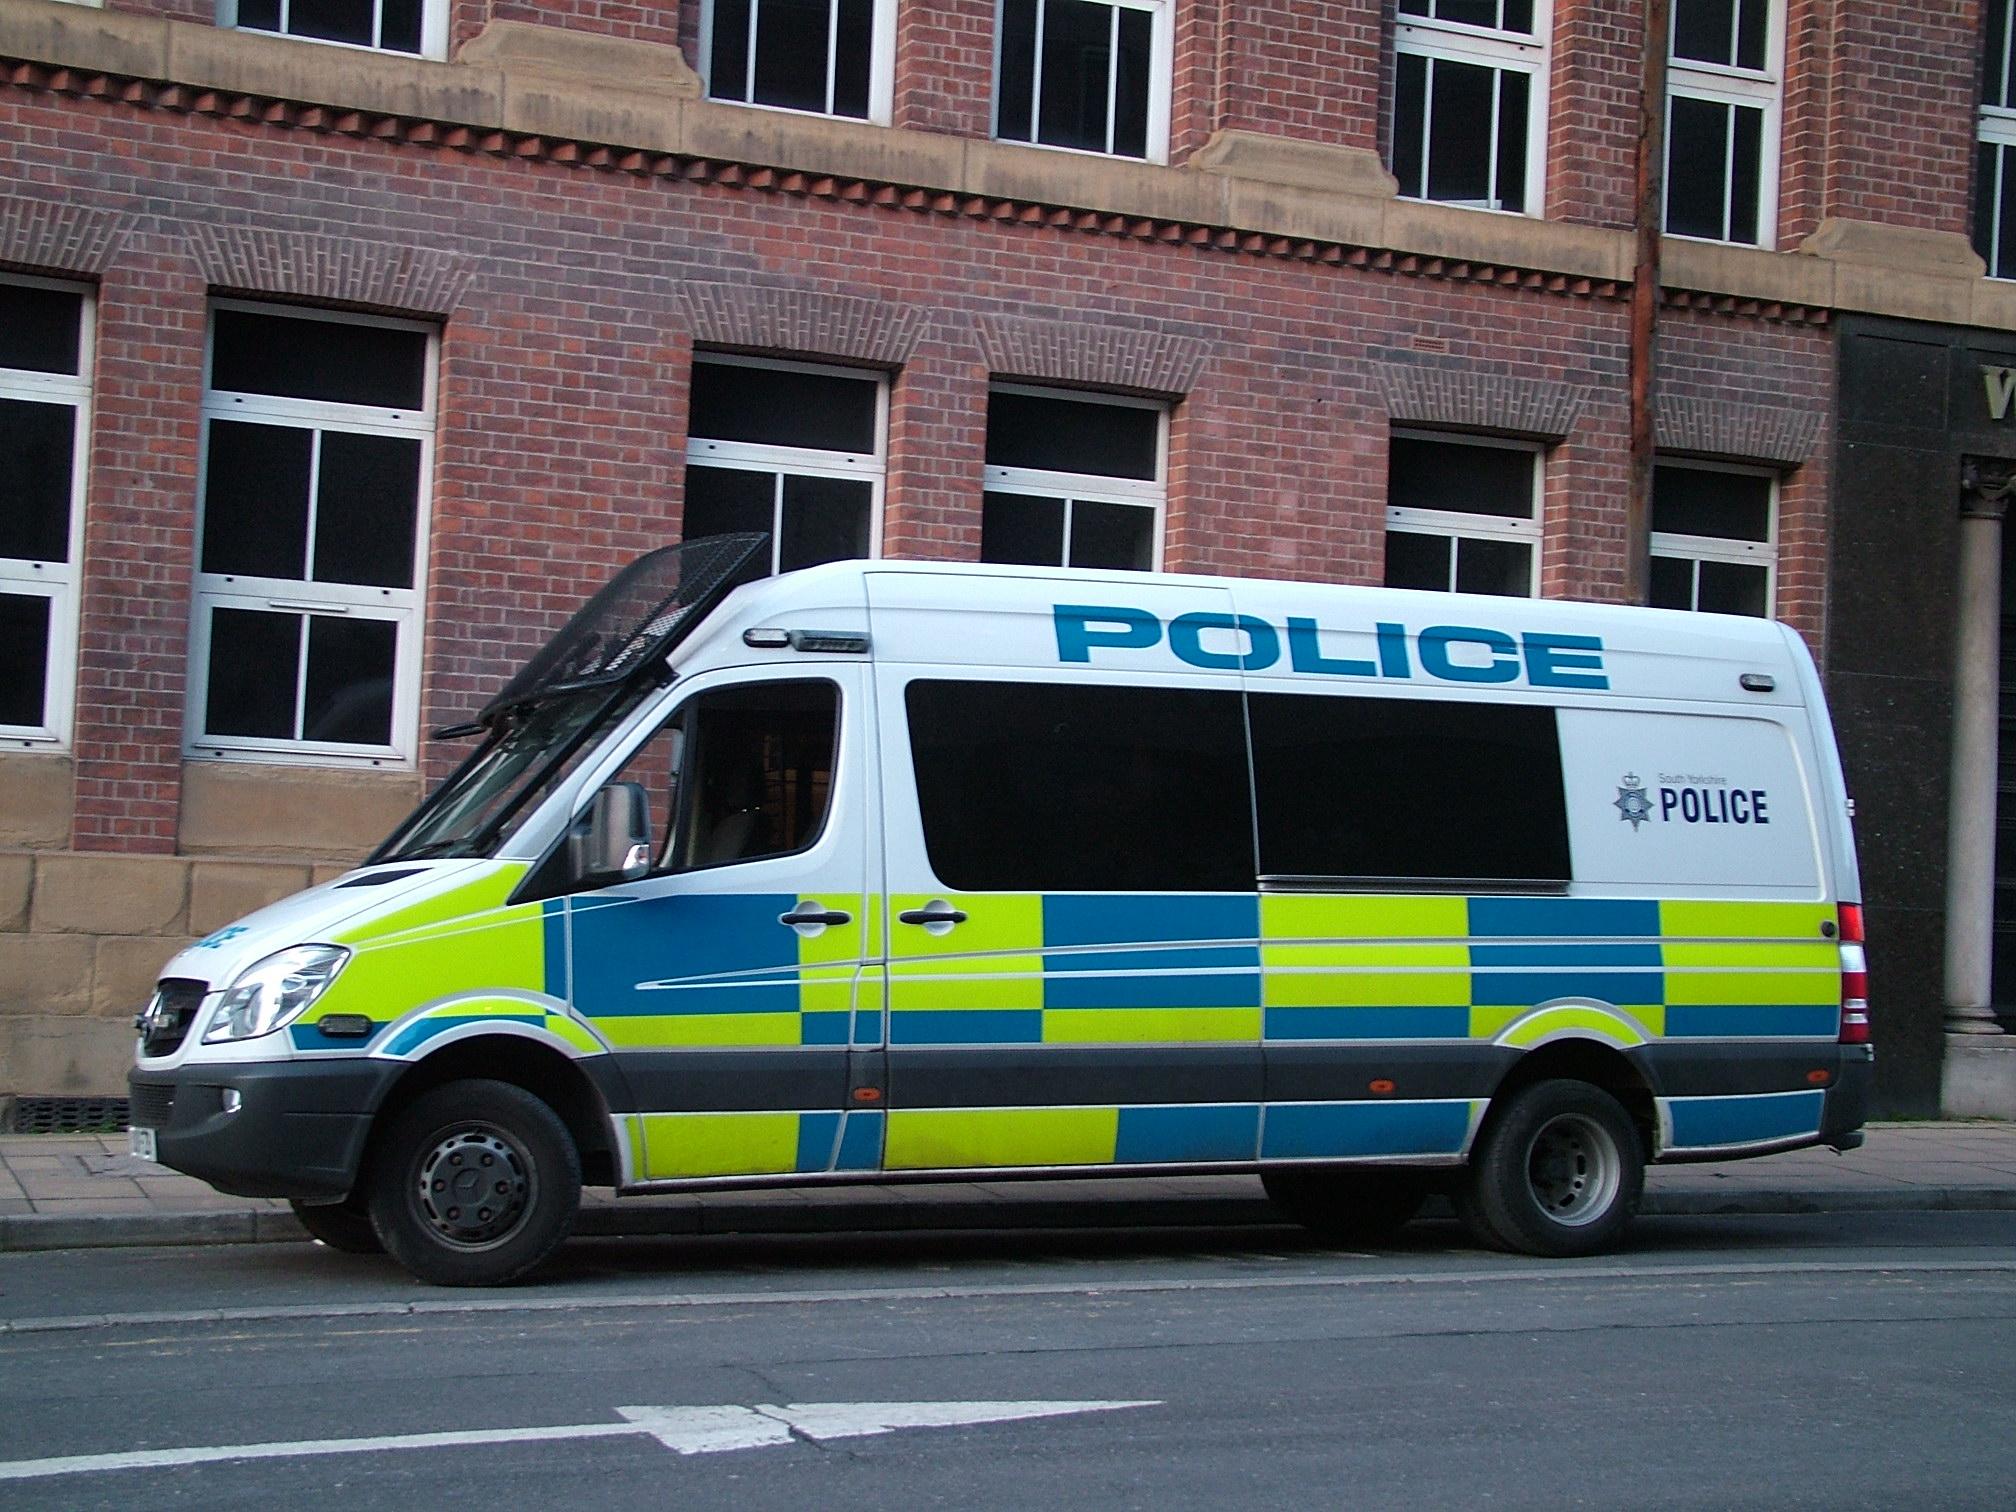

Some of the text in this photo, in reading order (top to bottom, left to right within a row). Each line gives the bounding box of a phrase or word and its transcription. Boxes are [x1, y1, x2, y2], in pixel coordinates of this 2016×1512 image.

[1052, 604, 1611, 690] POLICE
[1658, 772, 1728, 786] South Yorkshire
[1660, 787, 1769, 824] POLICE
